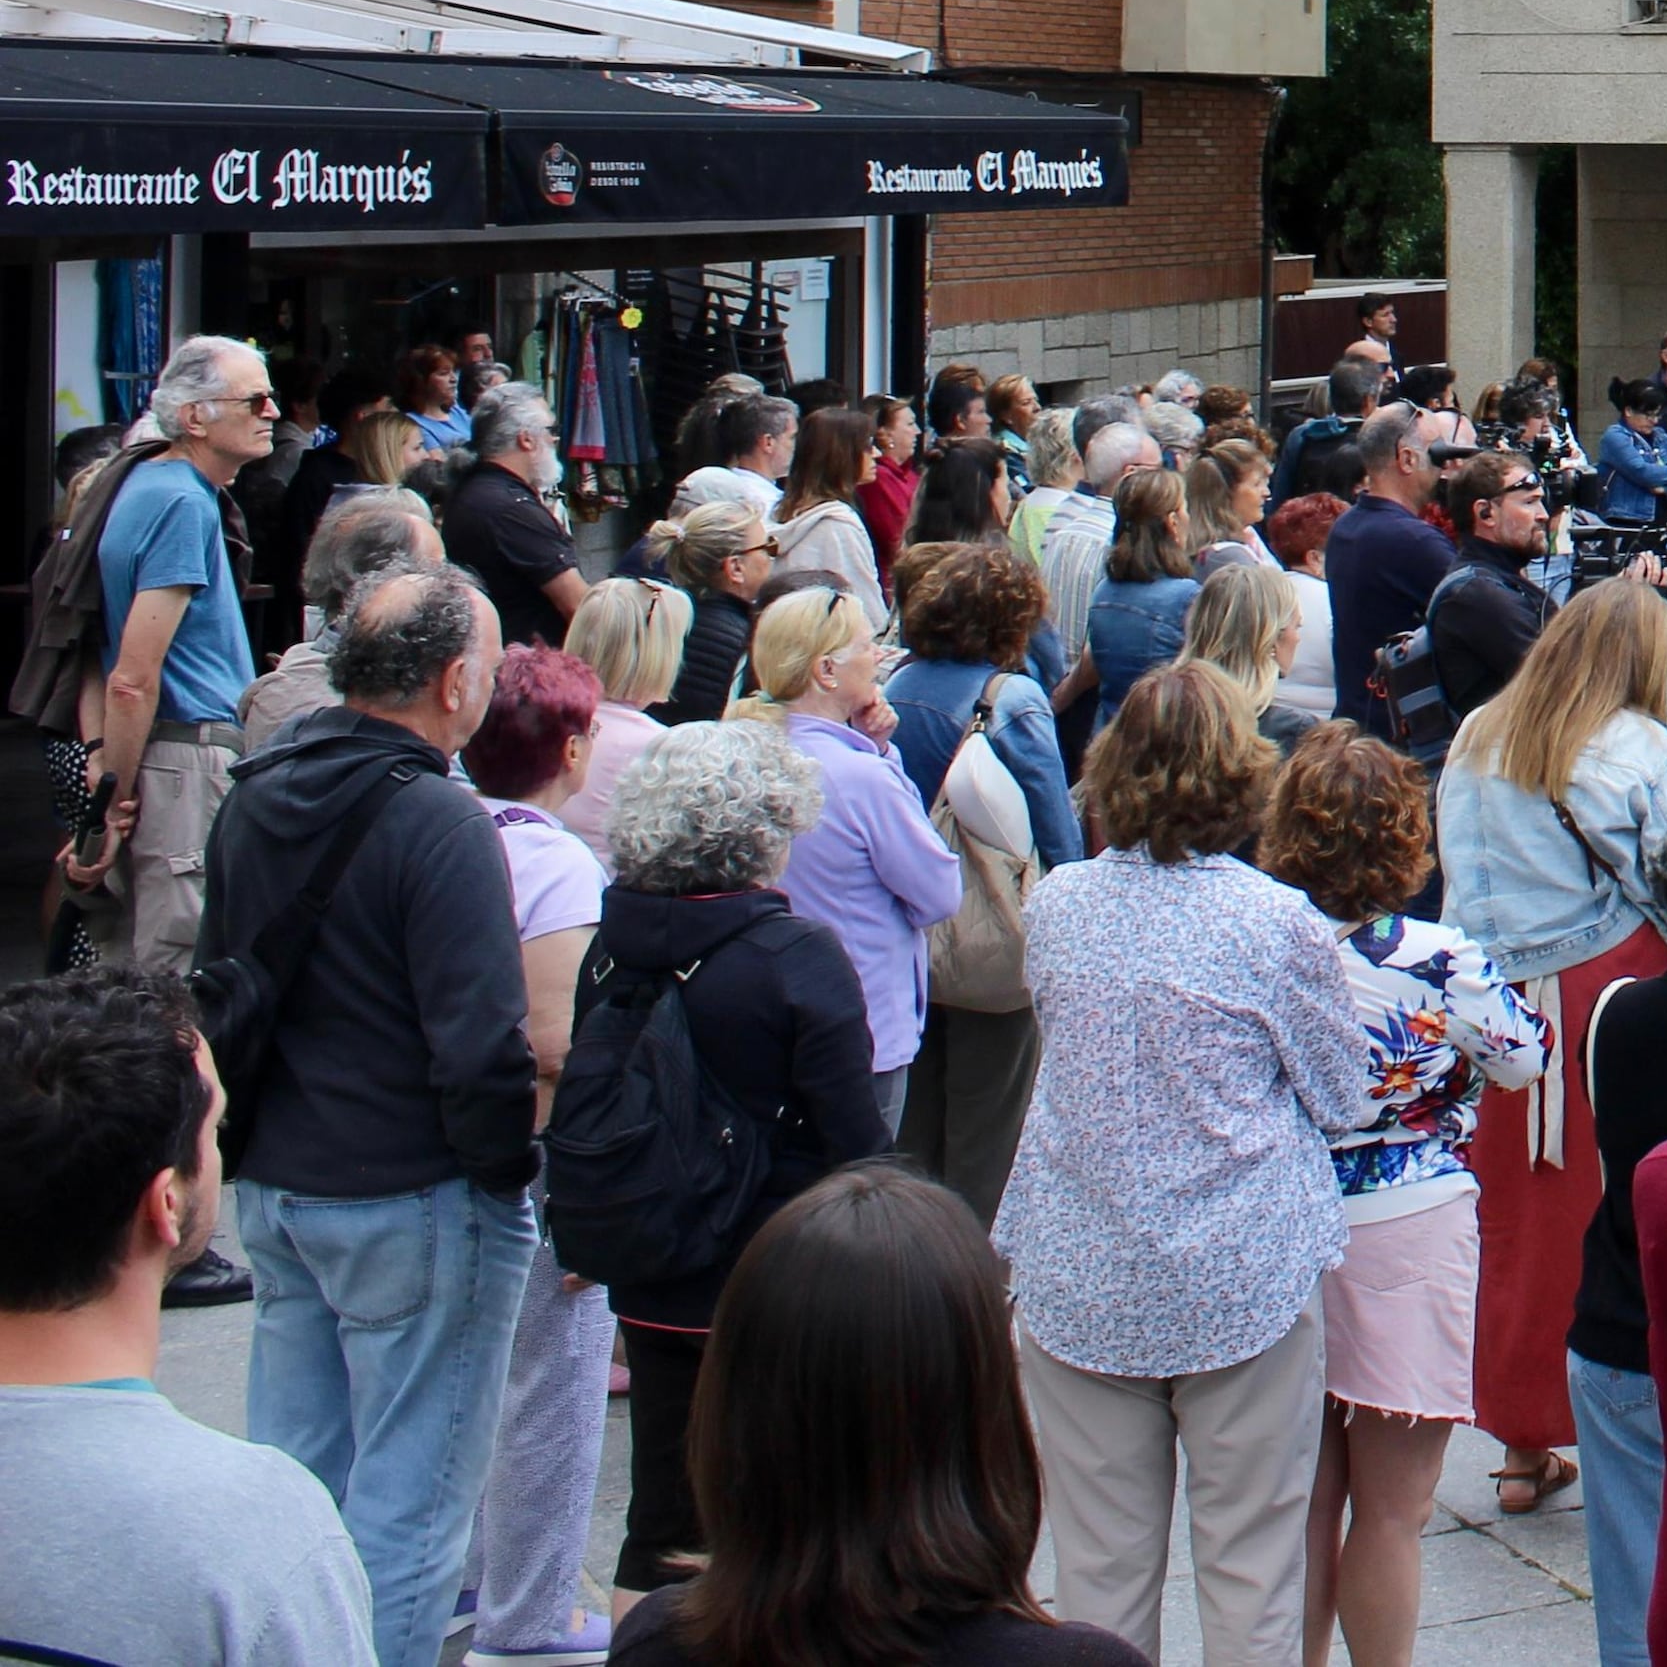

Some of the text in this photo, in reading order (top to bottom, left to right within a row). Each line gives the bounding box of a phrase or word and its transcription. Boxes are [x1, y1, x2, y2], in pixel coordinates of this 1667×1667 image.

[6, 148, 432, 213] Restaurante El Marqués
[590, 162, 646, 171] RESISTENCIA
[867, 148, 1103, 197] Restaurante El Marqués
[590, 177, 618, 187] DESDE
